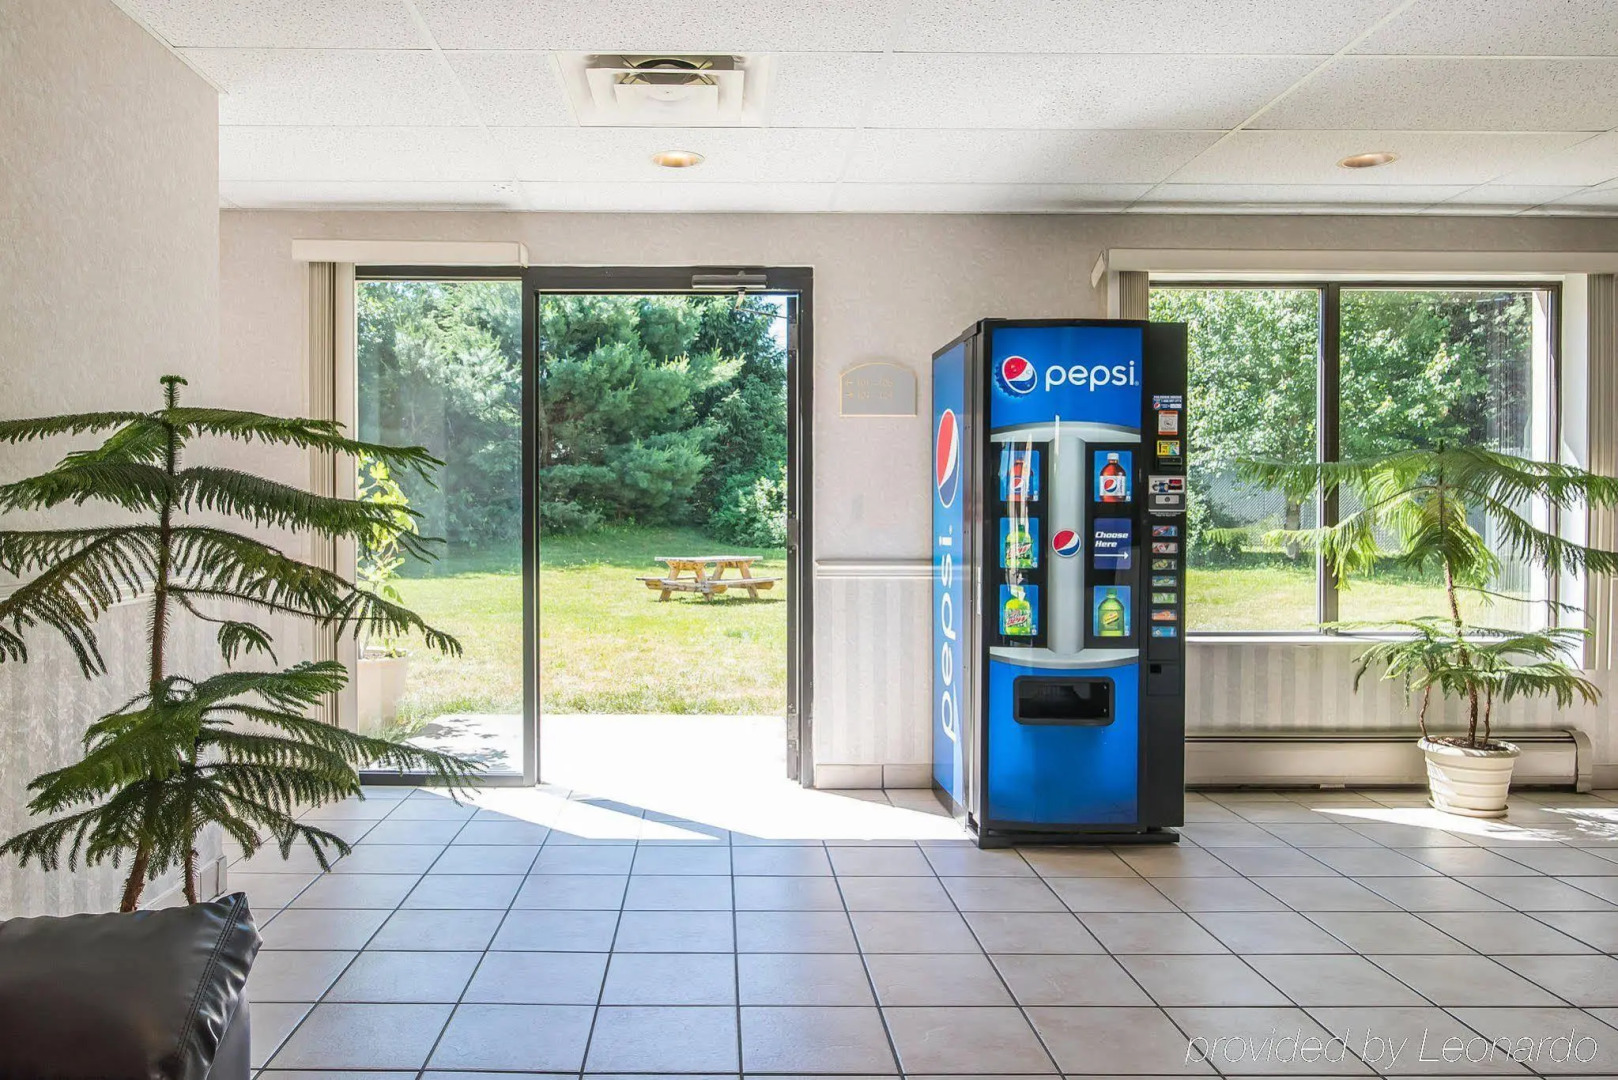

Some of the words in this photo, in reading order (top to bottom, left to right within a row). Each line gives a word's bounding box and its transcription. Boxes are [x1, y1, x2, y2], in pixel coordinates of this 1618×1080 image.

[1045, 360, 1135, 392] pepsi
[1094, 531, 1129, 539] Choose
[1094, 540, 1118, 548] Here
[938, 536, 956, 742] pepsi
